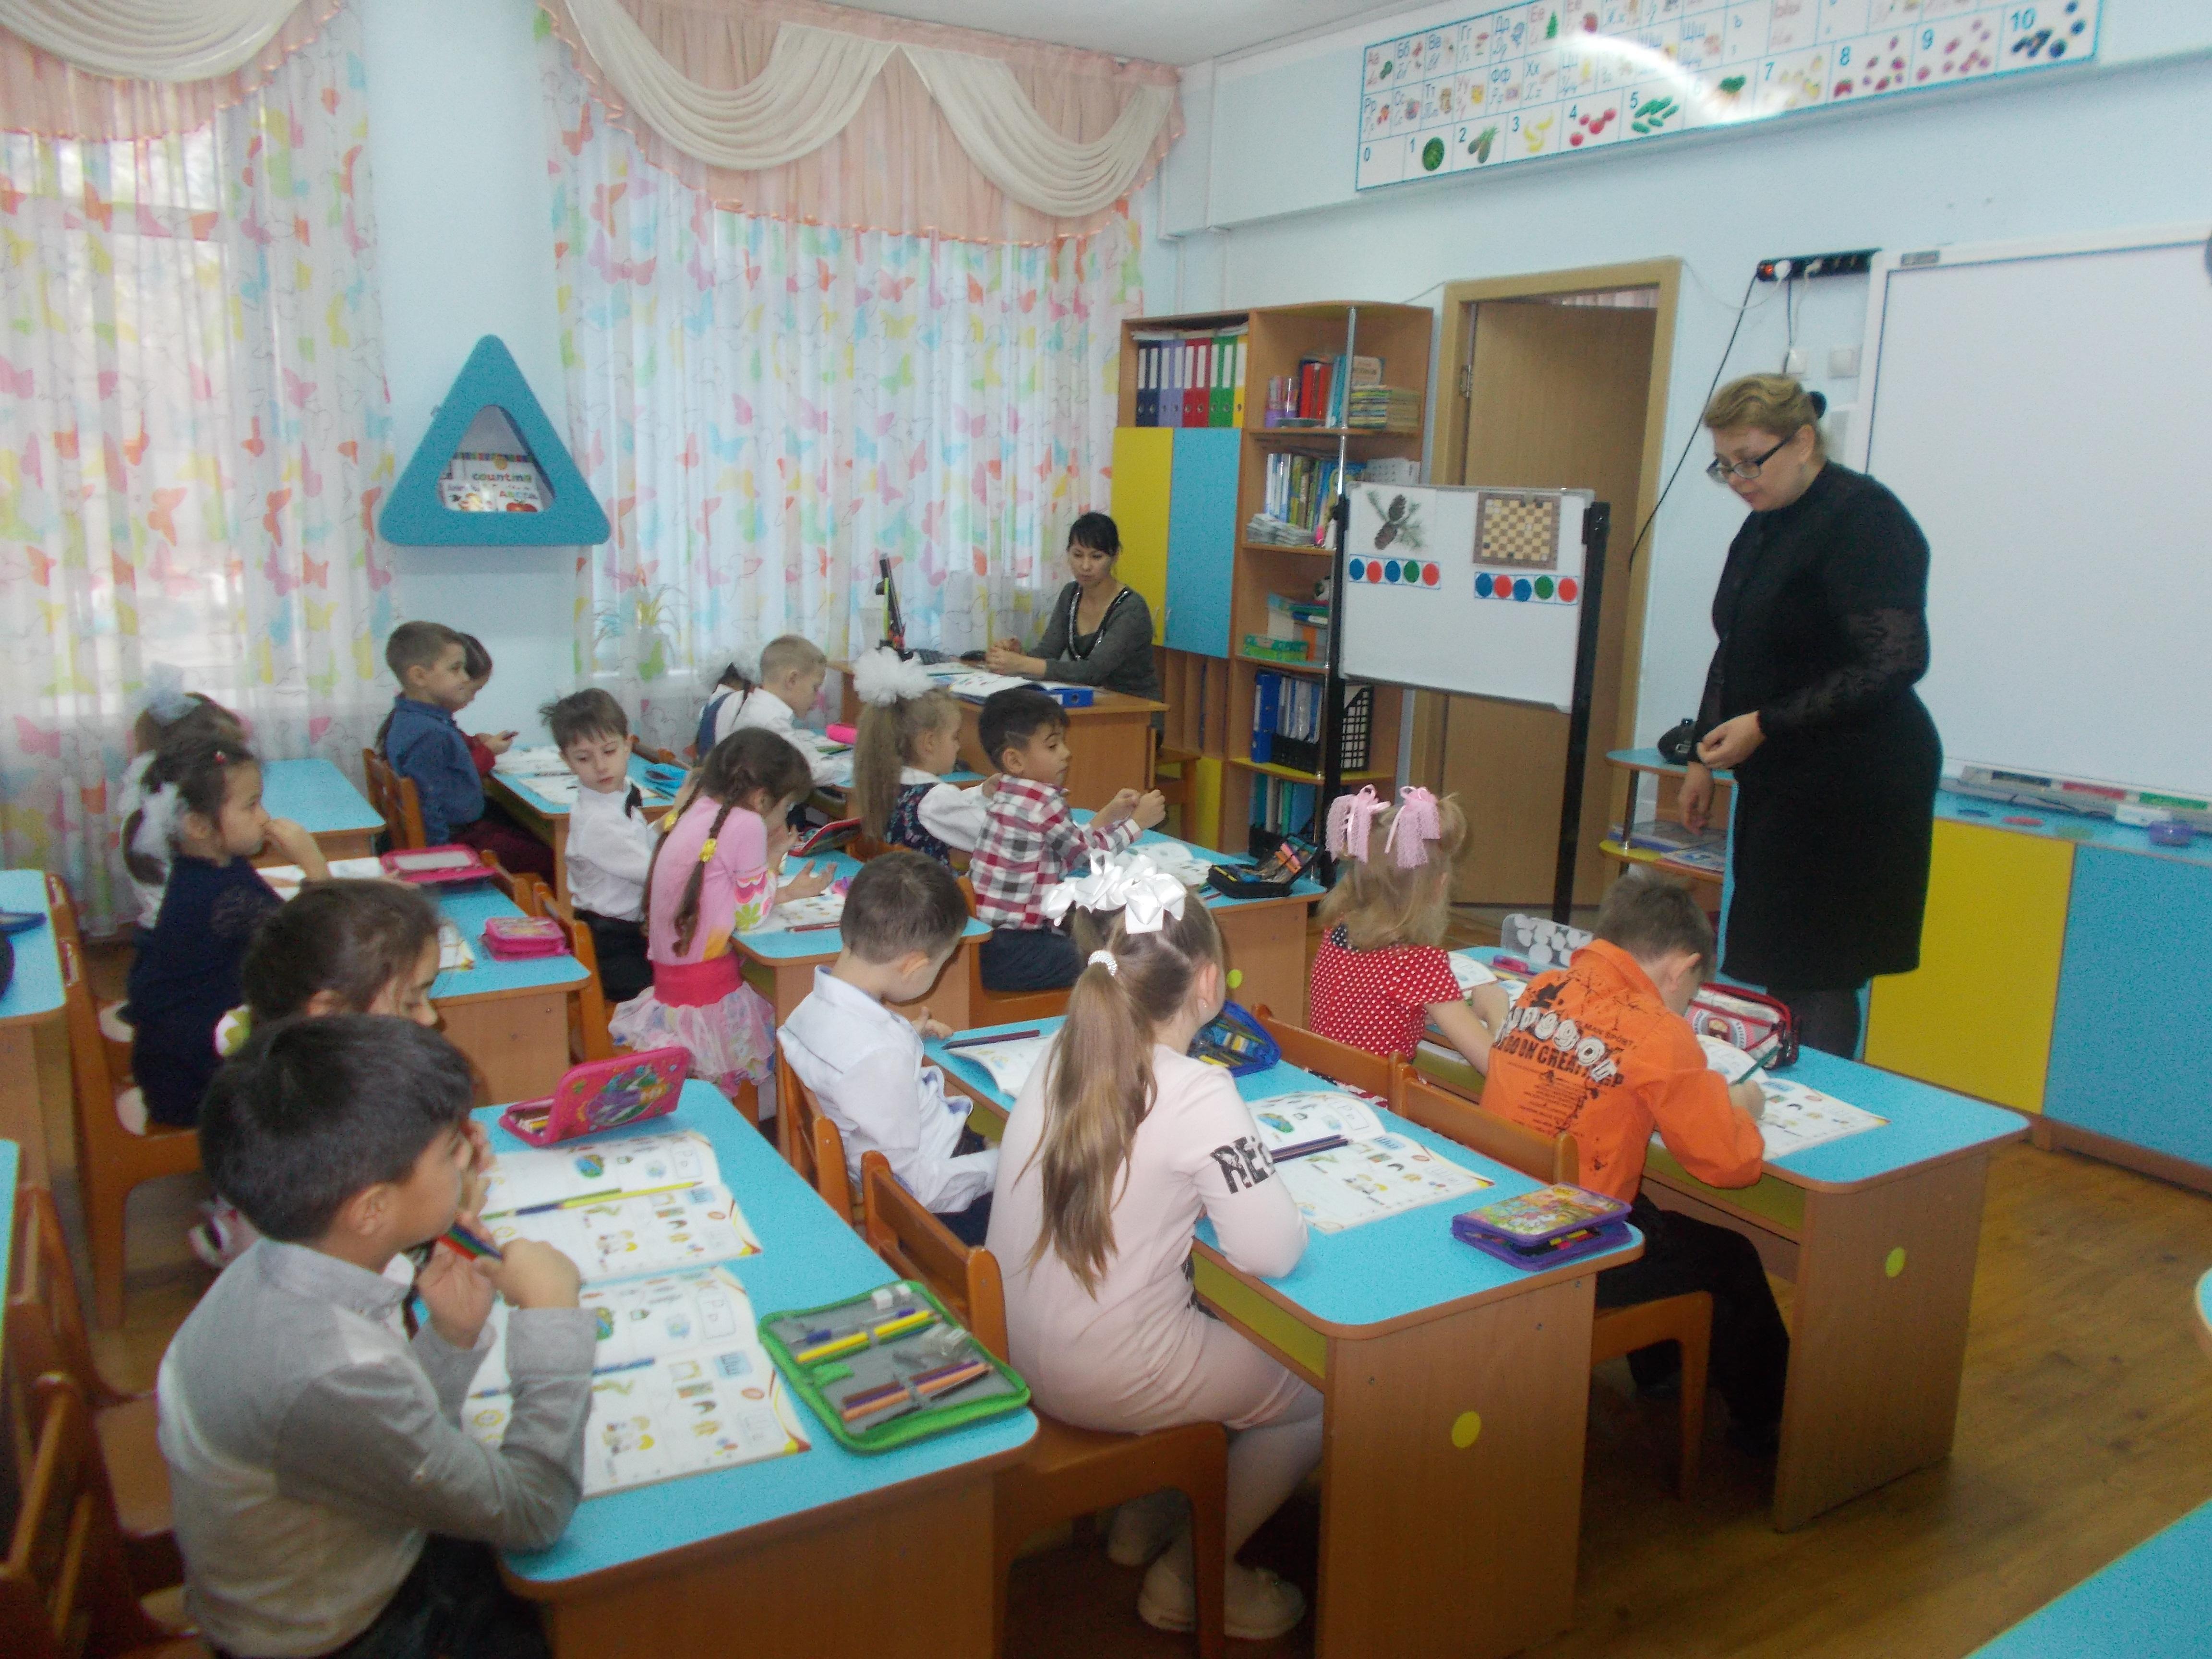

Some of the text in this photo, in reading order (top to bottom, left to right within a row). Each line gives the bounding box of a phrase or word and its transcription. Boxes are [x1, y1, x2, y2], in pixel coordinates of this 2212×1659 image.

[2010, 8, 2036, 32] 10
[1922, 28, 1935, 50] 9
[1839, 46, 1851, 66] 8
[1765, 61, 1775, 81] 7
[1631, 91, 1639, 109] 5
[1569, 104, 1578, 120] 4
[1512, 116, 1520, 132] 3
[1458, 127, 1467, 144] 2
[1409, 137, 1416, 154] 1
[1364, 147, 1371, 162] 0
